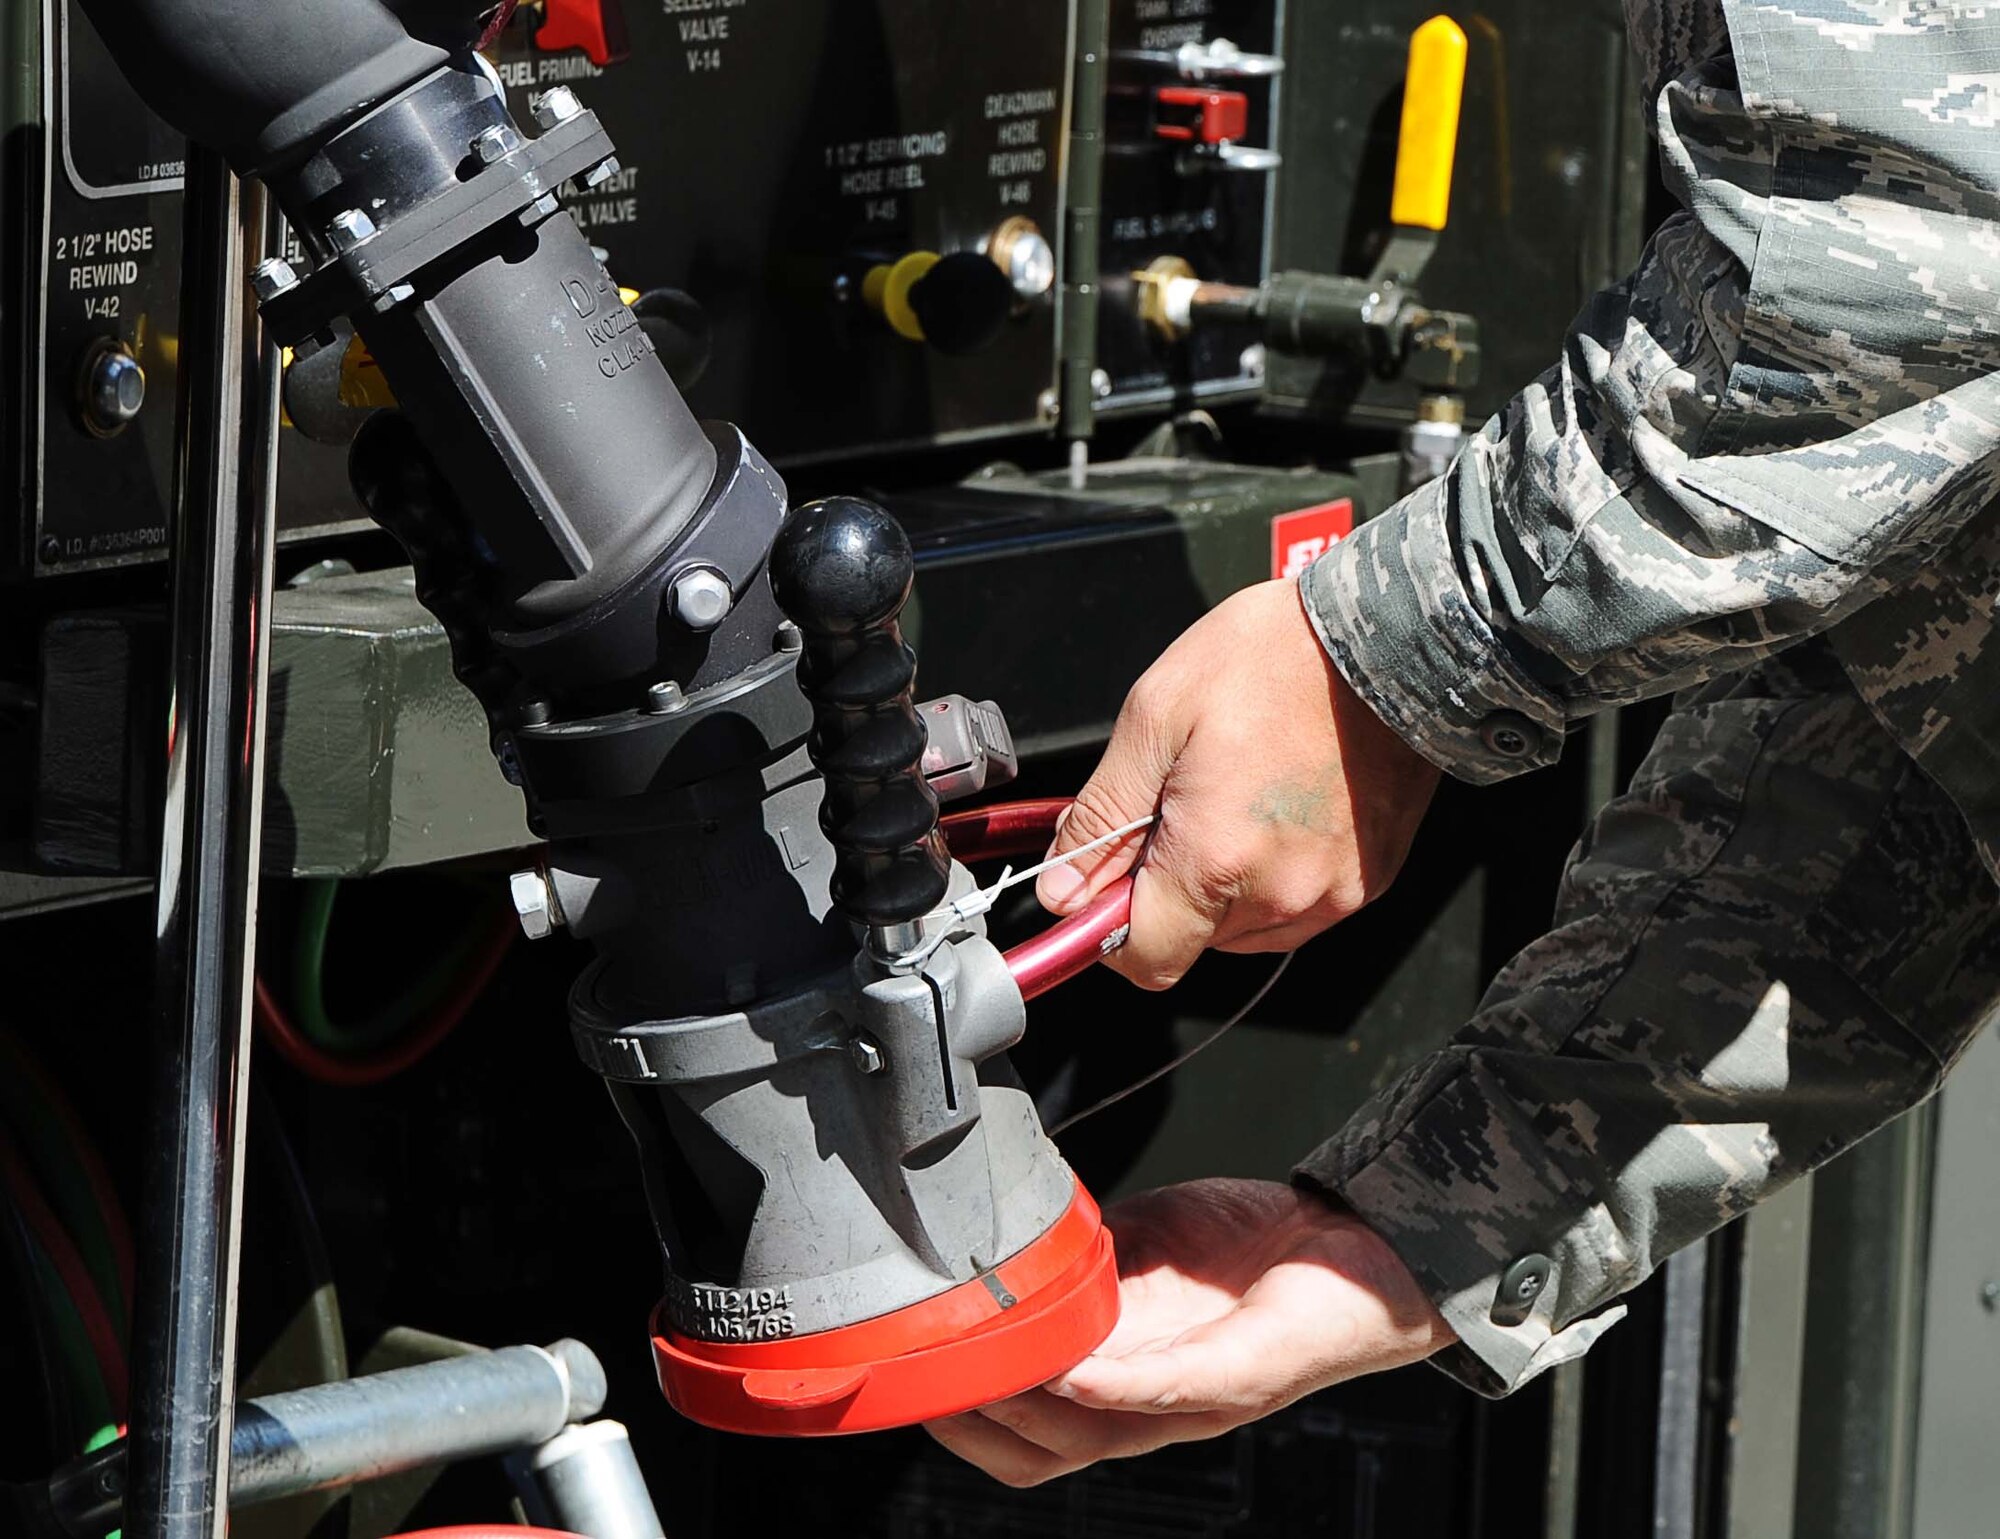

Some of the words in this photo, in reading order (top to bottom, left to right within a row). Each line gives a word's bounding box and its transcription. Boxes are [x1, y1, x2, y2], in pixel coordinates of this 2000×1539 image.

[663, 0, 746, 14] SELE
[679, 16, 729, 42] VALVE
[687, 49, 720, 72] V-14
[500, 62, 536, 87] FUEL
[998, 119, 1040, 146] HOSE
[987, 147, 1047, 177] REWIND
[589, 198, 637, 225] VALVE
[56, 237, 67, 260] 2
[105, 226, 153, 254] HOSE
[70, 260, 138, 290] REWIND
[85, 296, 120, 320] V-42
